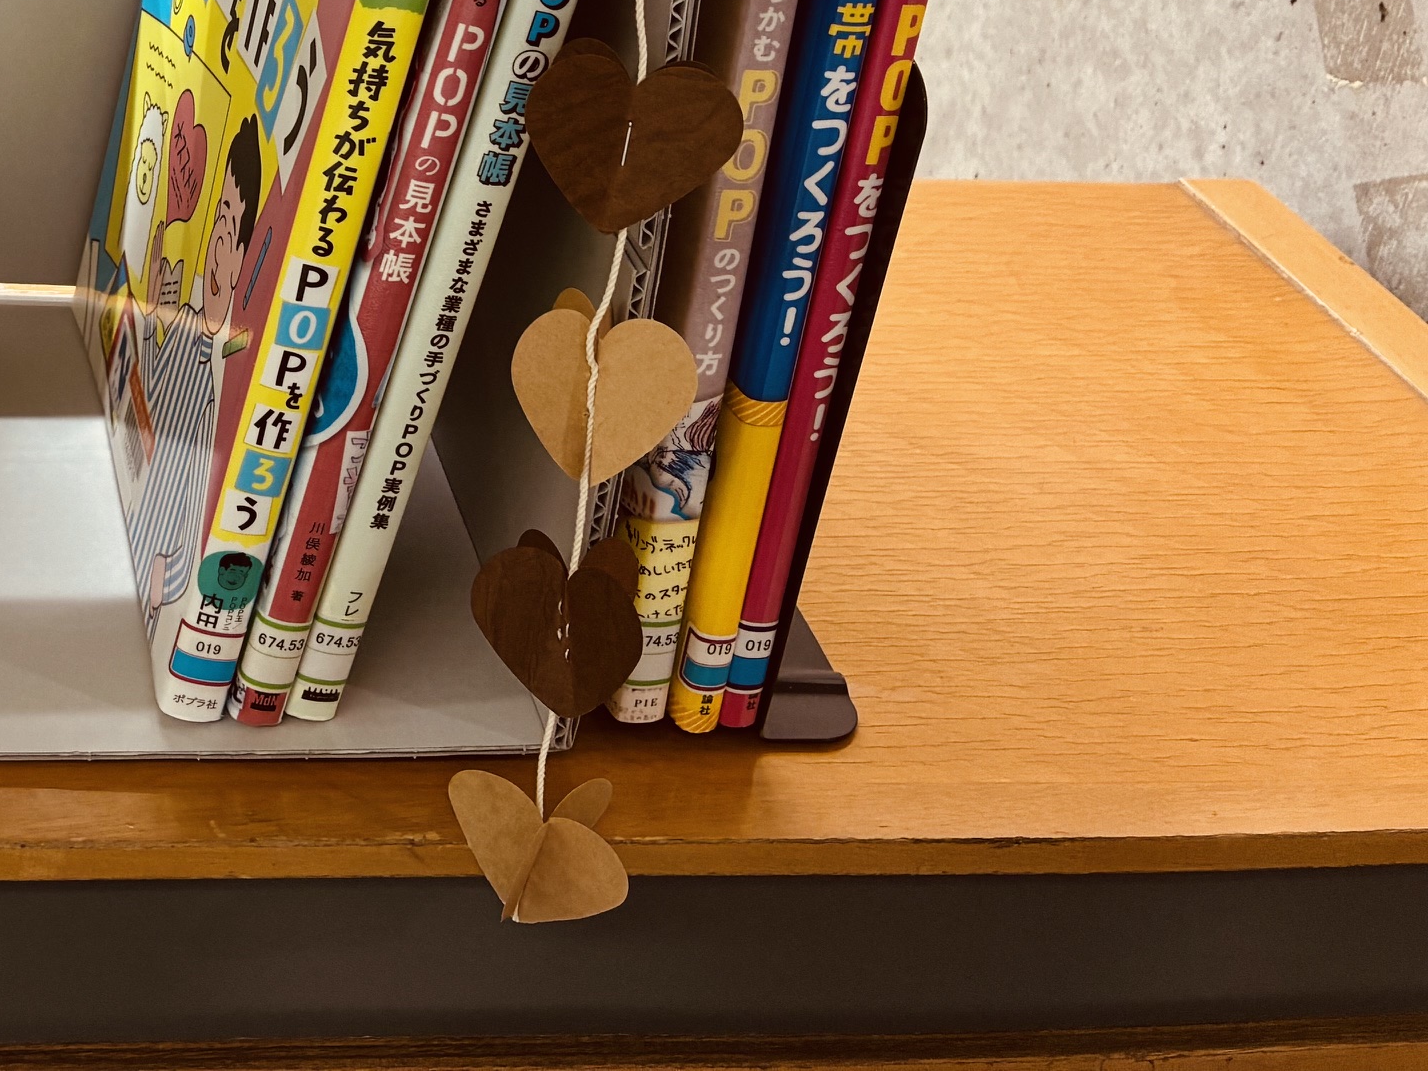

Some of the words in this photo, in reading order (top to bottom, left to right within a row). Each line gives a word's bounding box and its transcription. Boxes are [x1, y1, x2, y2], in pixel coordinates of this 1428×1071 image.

[370, 200, 493, 530] さまざまな業種の手づくりPOP実例集
[258, 633, 305, 651] 674.53
[316, 633, 361, 648] 674.53
[745, 639, 771, 652] 019
[196, 641, 221, 655] 019
[707, 643, 732, 656] 019
[173, 694, 218, 709] ポプラ社
[634, 698, 659, 708] PIE
